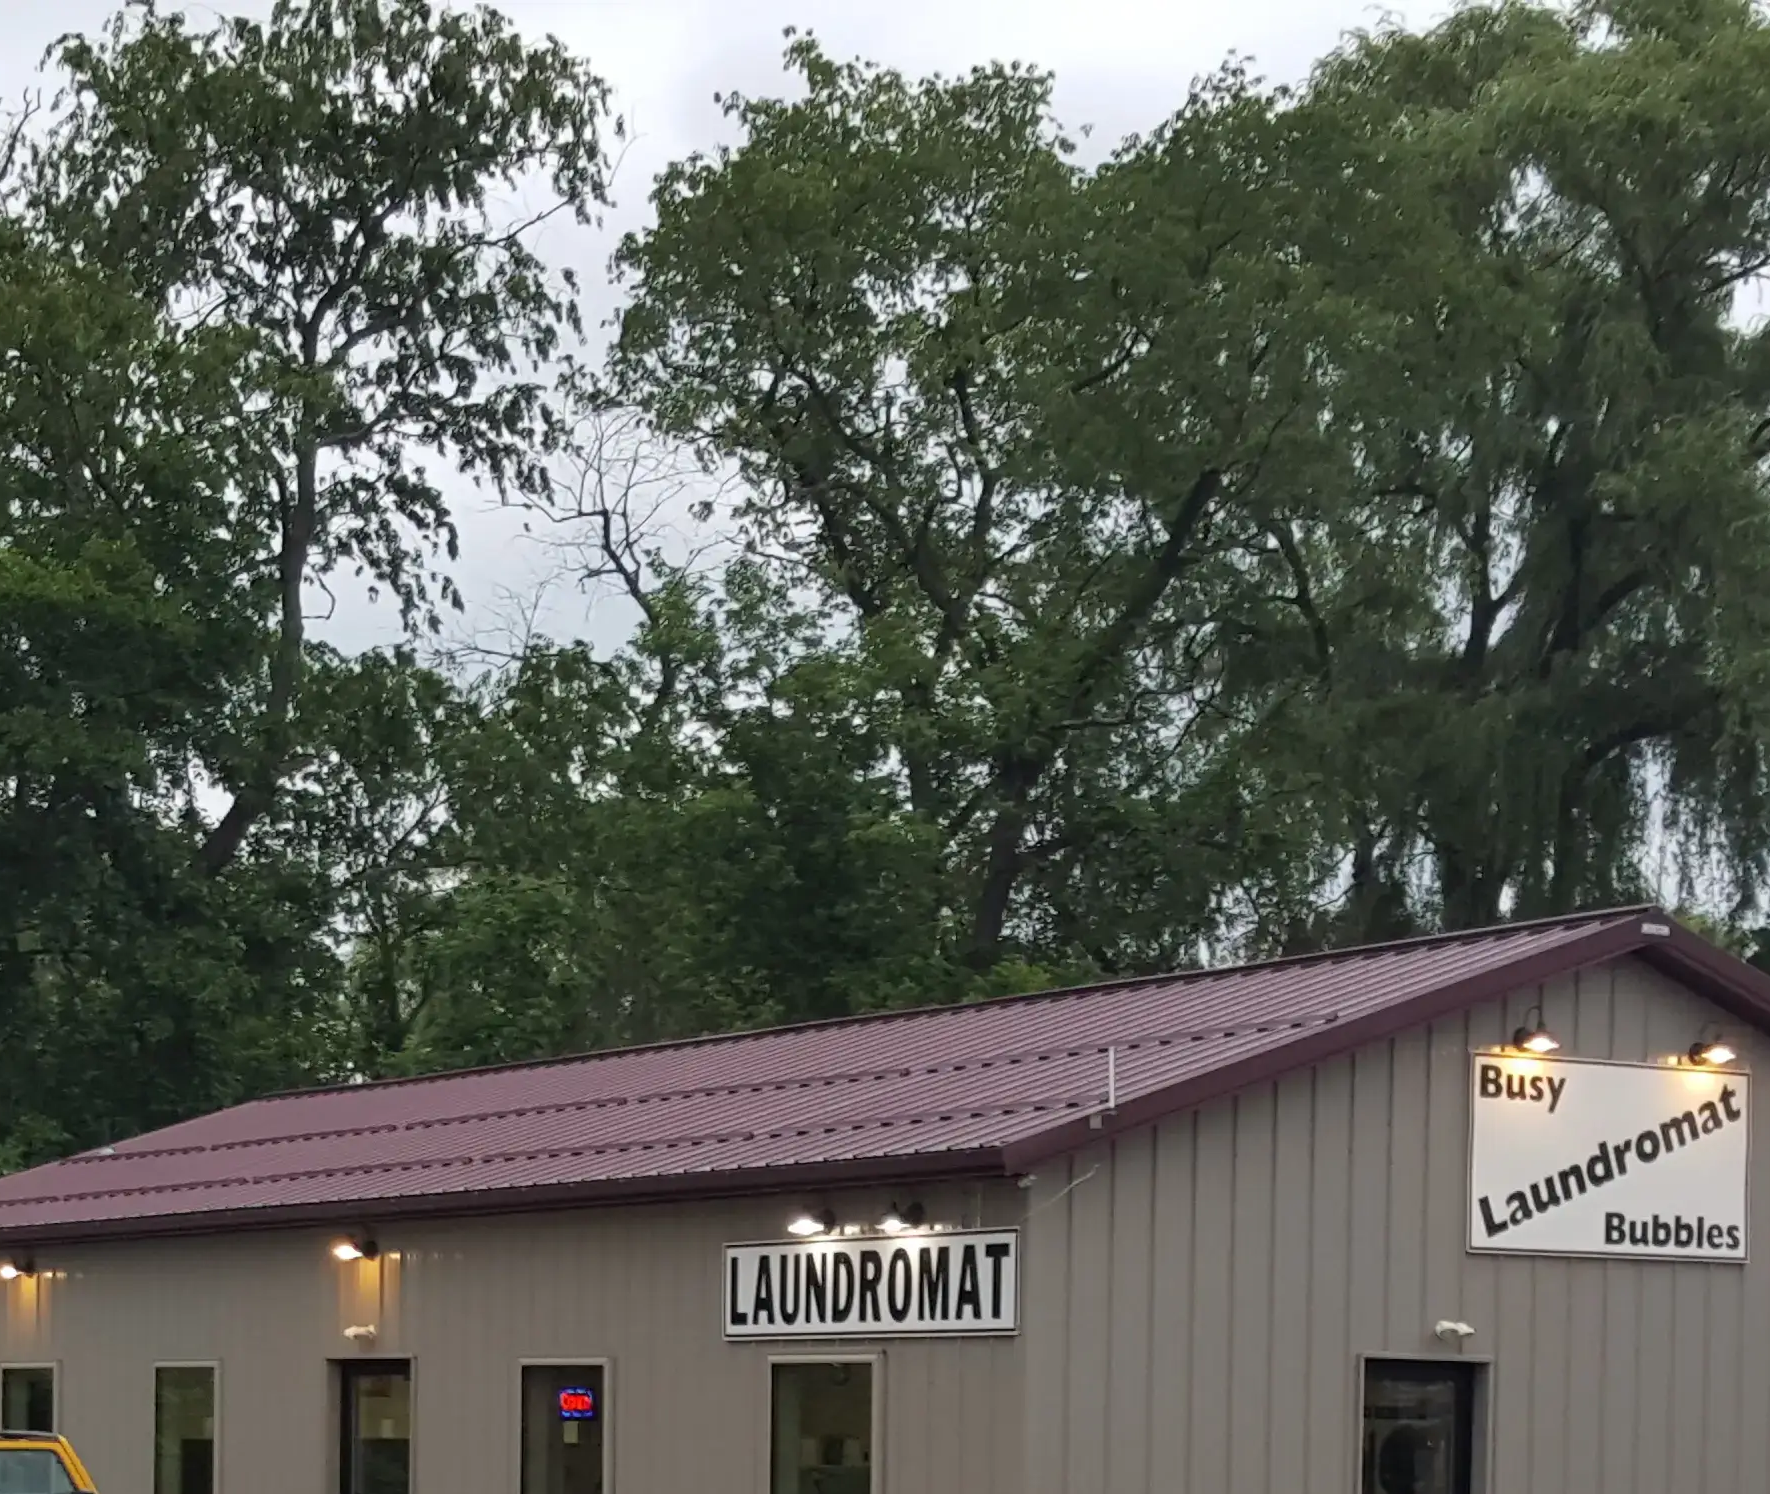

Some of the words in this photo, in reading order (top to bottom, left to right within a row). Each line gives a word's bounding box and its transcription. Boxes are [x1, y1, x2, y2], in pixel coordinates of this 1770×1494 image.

[1480, 1064, 1566, 1112] Busy
[1478, 1083, 1742, 1238] Laundromat
[1604, 1212, 1740, 1250] Bubbles
[730, 1242, 1011, 1326] LAUNDROMAT
